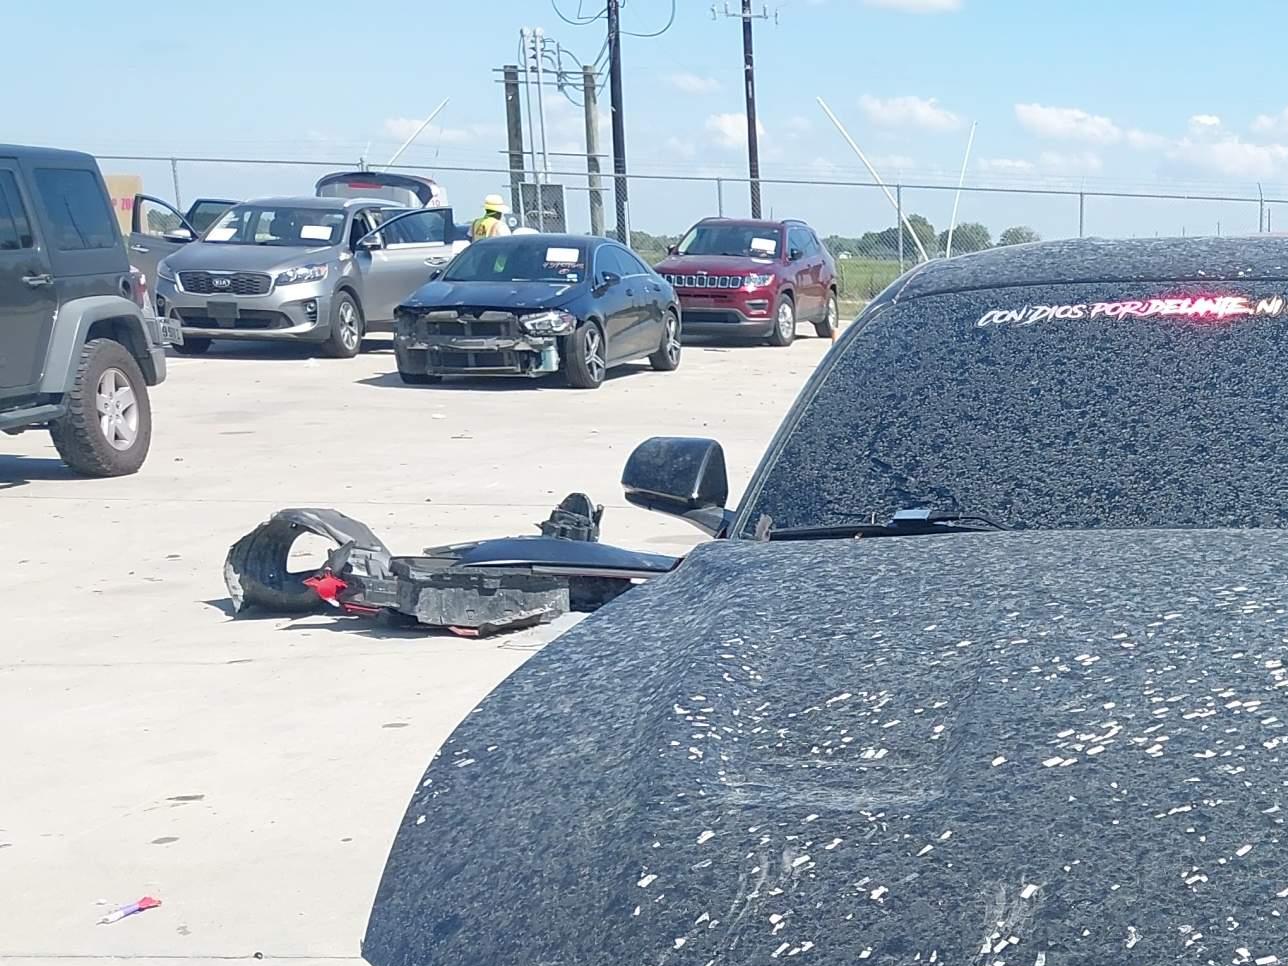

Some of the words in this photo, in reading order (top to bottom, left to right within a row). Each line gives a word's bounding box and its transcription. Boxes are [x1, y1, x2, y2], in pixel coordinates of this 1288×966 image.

[977, 306, 1027, 327] CON
[1024, 303, 1087, 327] DIOS
[1090, 301, 1146, 320] POR
[1256, 296, 1283, 314] NI
